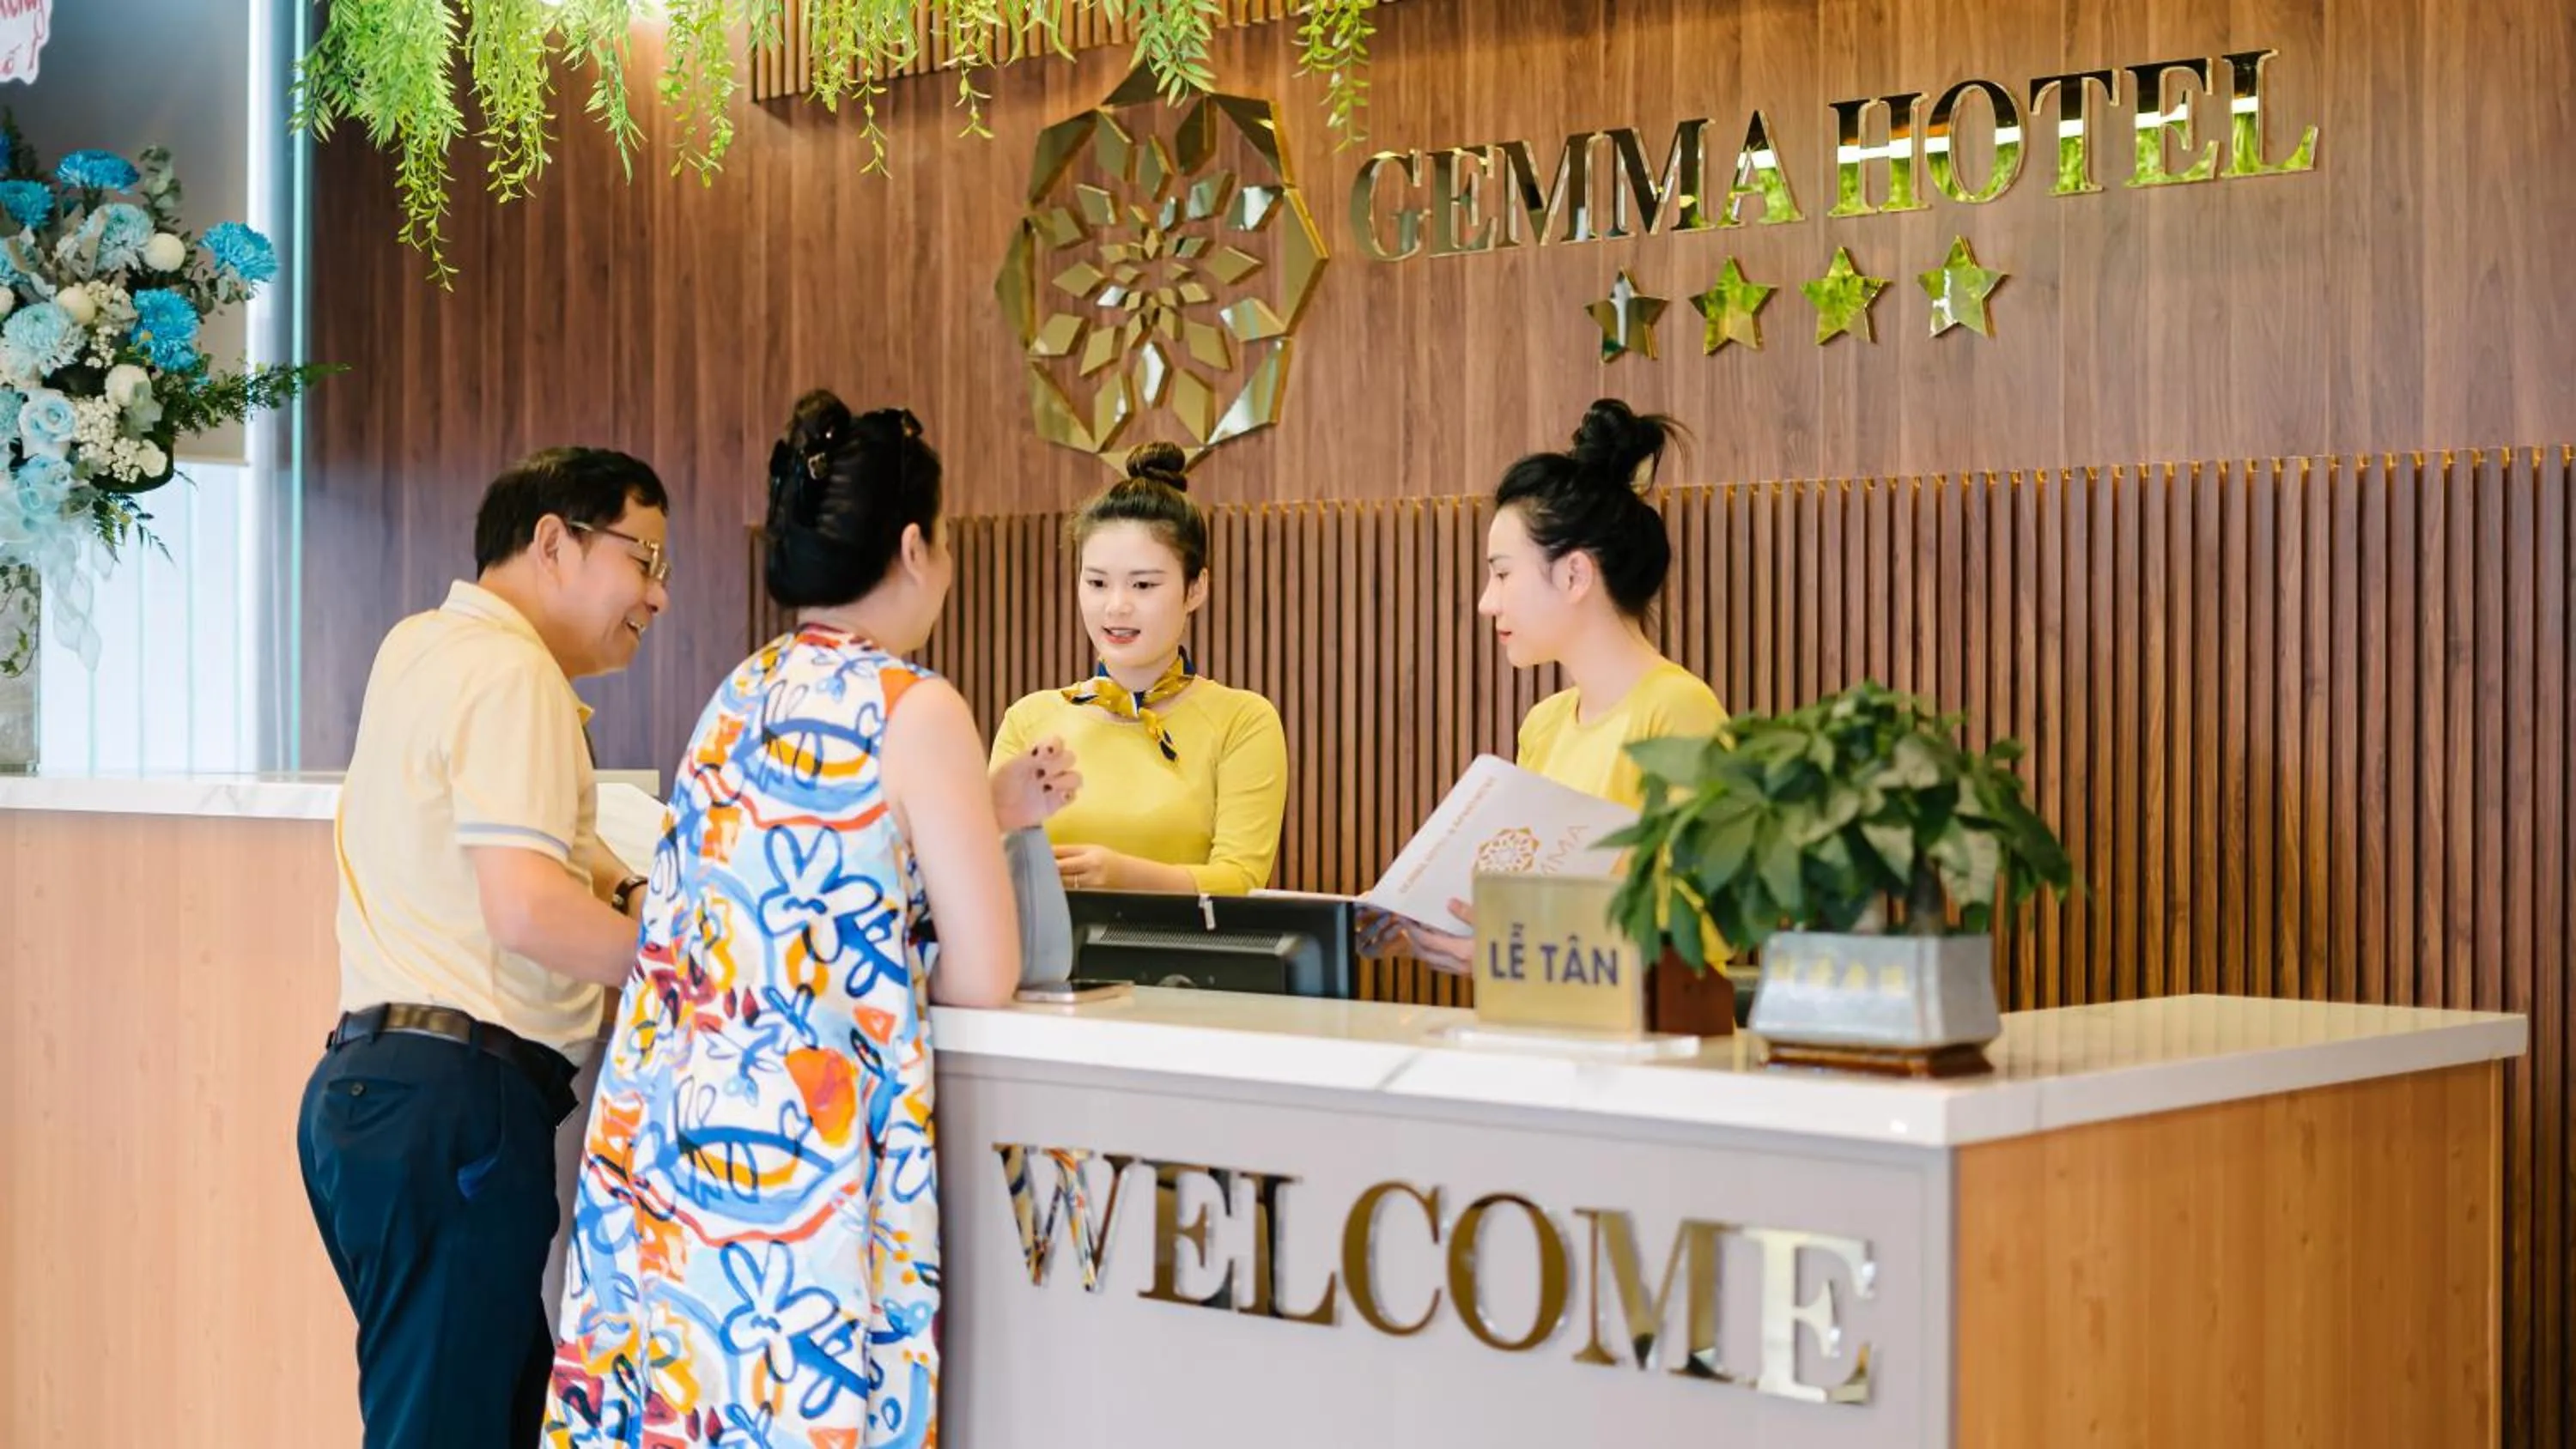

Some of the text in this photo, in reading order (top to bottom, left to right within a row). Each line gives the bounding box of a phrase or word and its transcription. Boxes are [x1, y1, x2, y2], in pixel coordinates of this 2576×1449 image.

[1351, 48, 2320, 262] GEMMA HOTEL
[1489, 922, 1619, 986] LỄ TÂN
[993, 1143, 1877, 1405] WELCOME
